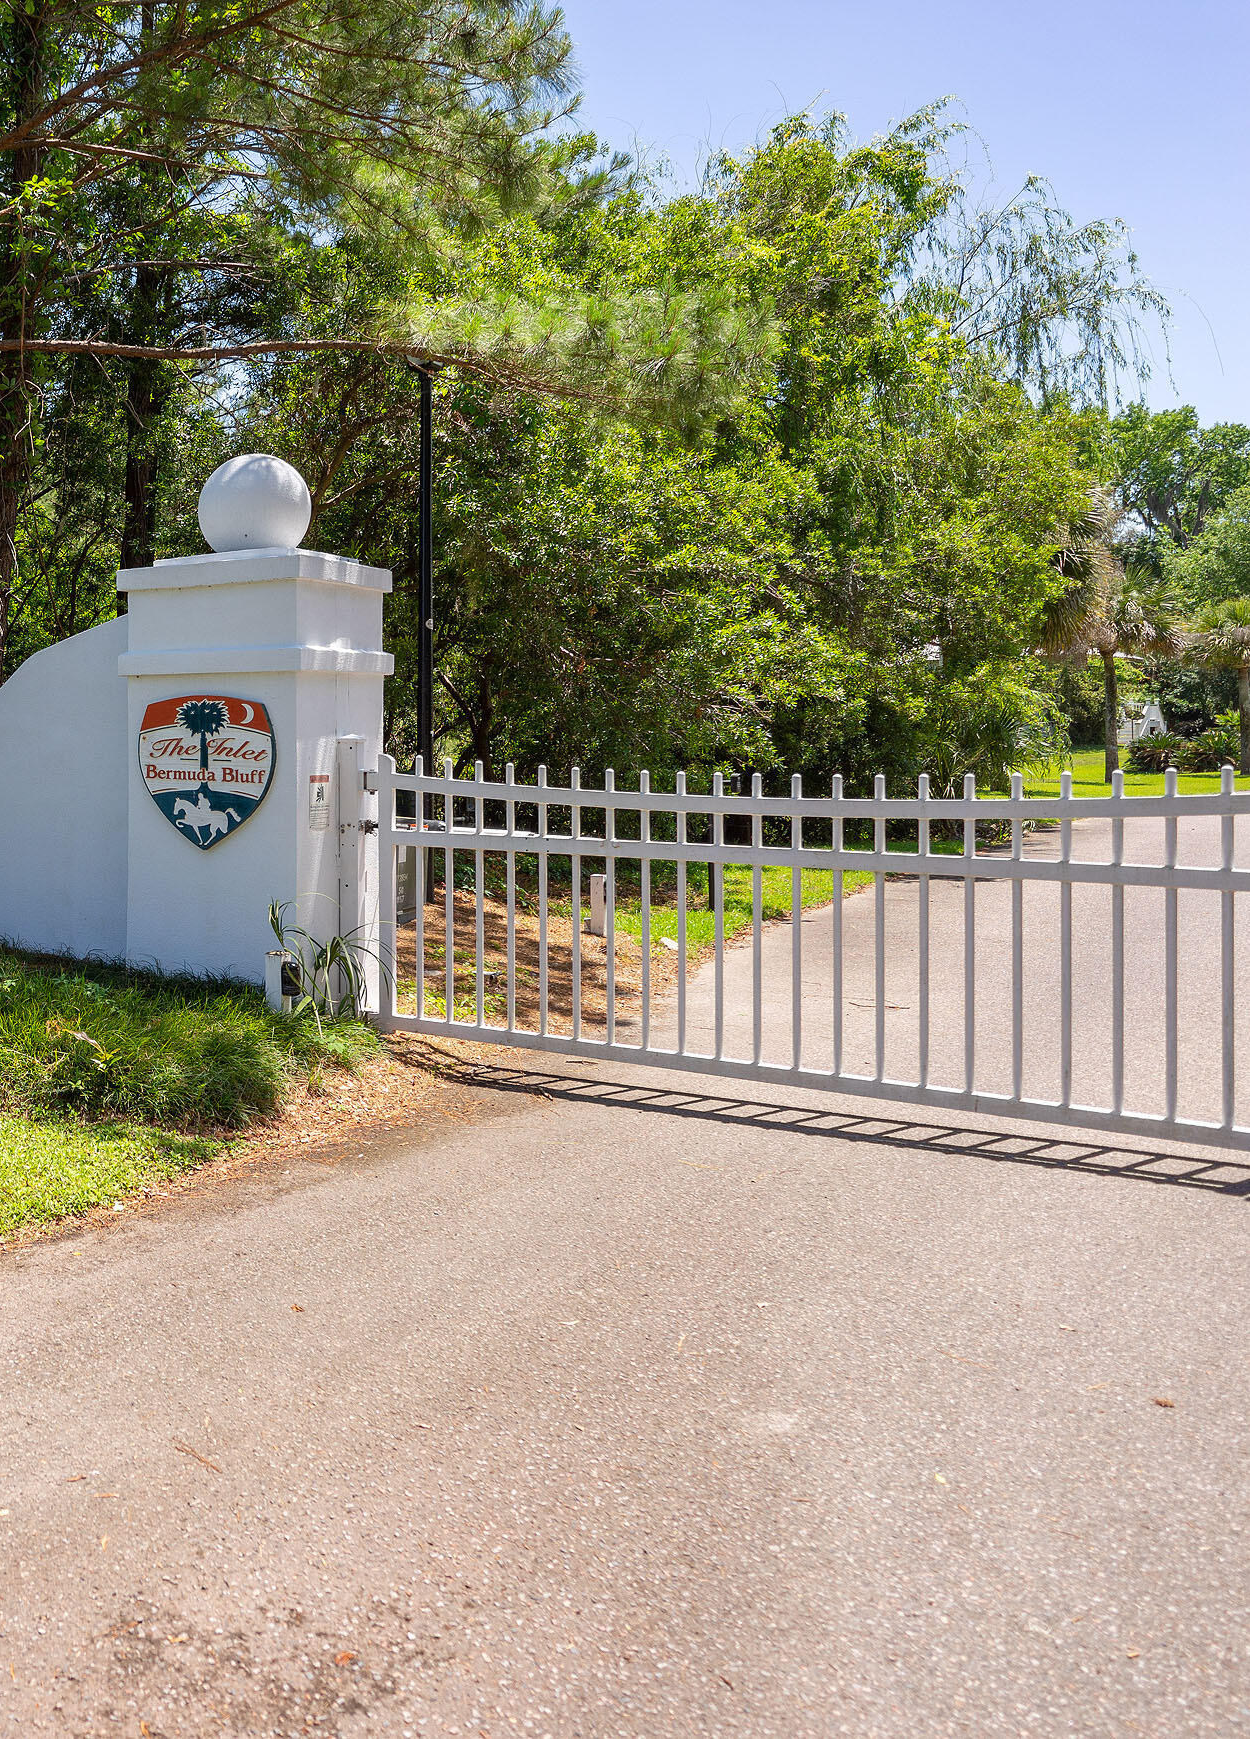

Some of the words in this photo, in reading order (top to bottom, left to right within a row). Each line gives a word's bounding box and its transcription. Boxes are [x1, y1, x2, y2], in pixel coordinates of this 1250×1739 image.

[150, 737, 200, 758] The
[206, 737, 268, 761] Inlet
[145, 764, 216, 782] Bermuda
[222, 767, 266, 784] Bluff
